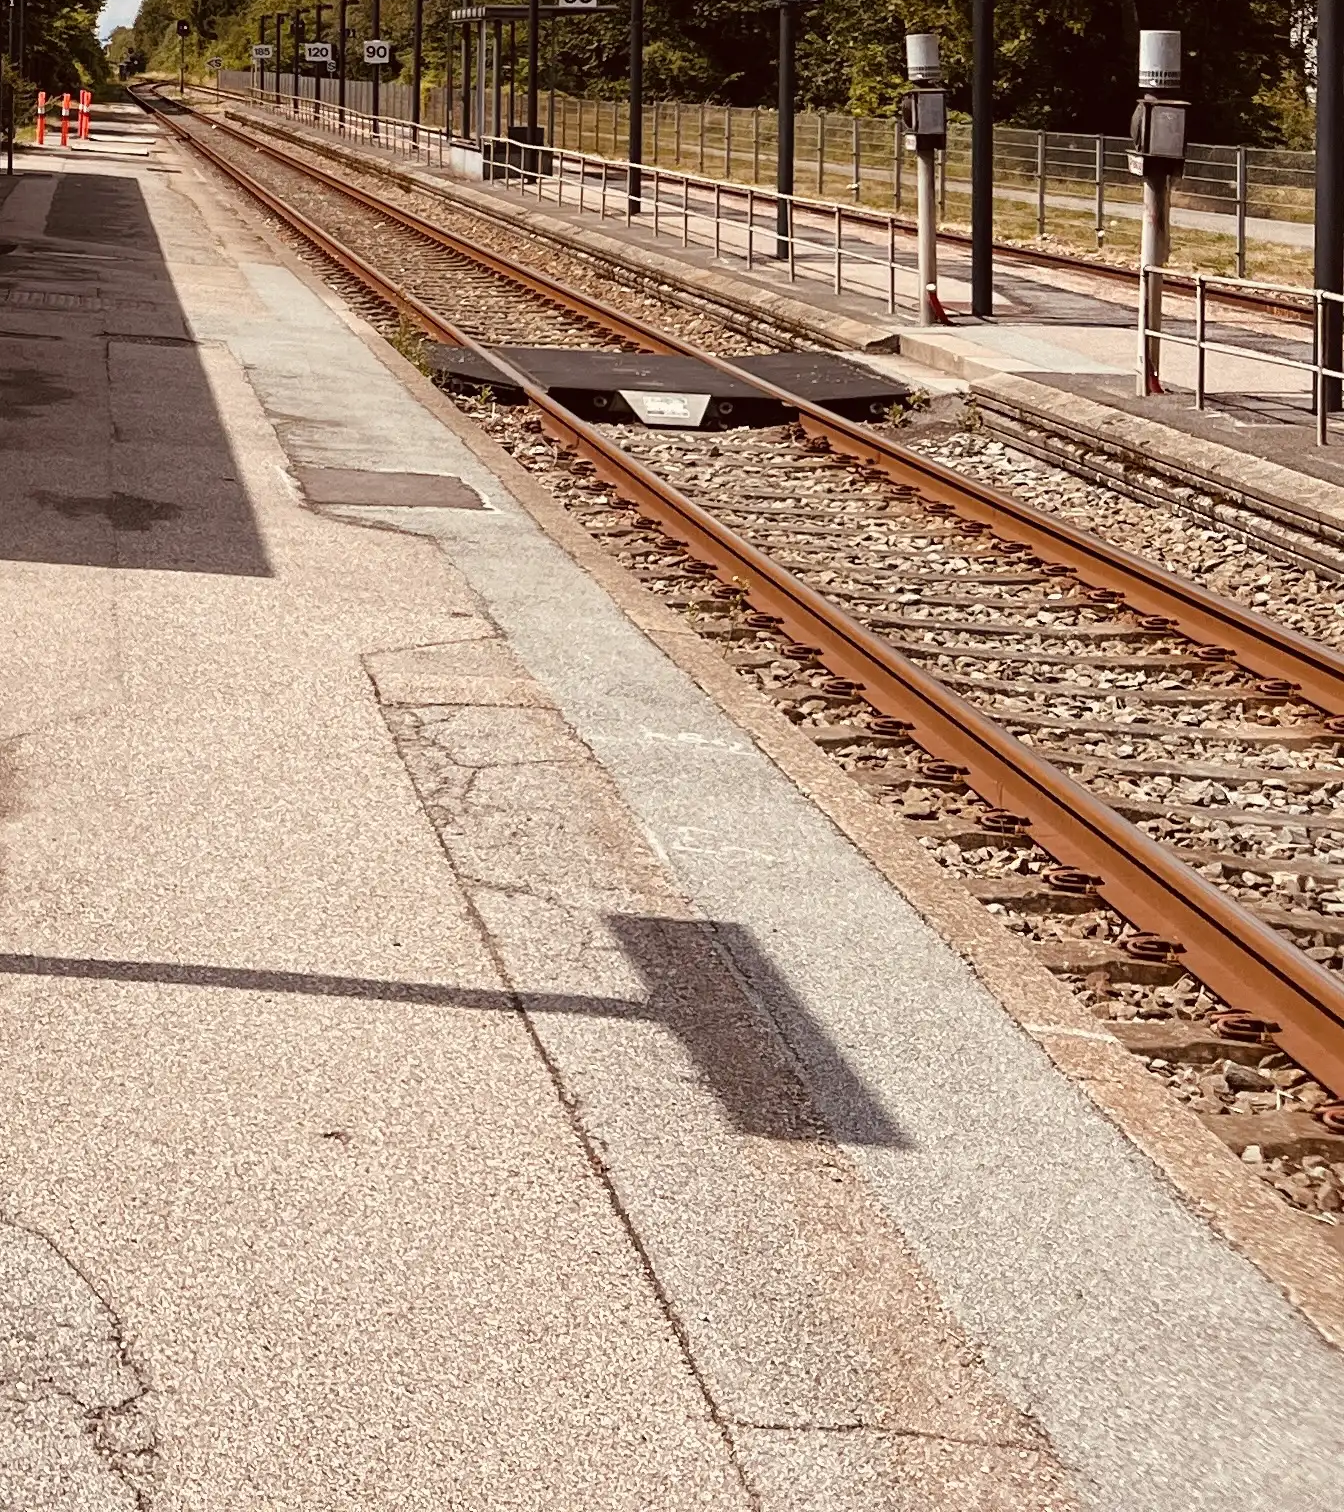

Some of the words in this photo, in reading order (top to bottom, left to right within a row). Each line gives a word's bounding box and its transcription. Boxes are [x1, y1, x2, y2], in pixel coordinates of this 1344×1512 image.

[254, 47, 270, 56] 185
[307, 47, 328, 57] 120
[366, 45, 387, 58] 90
